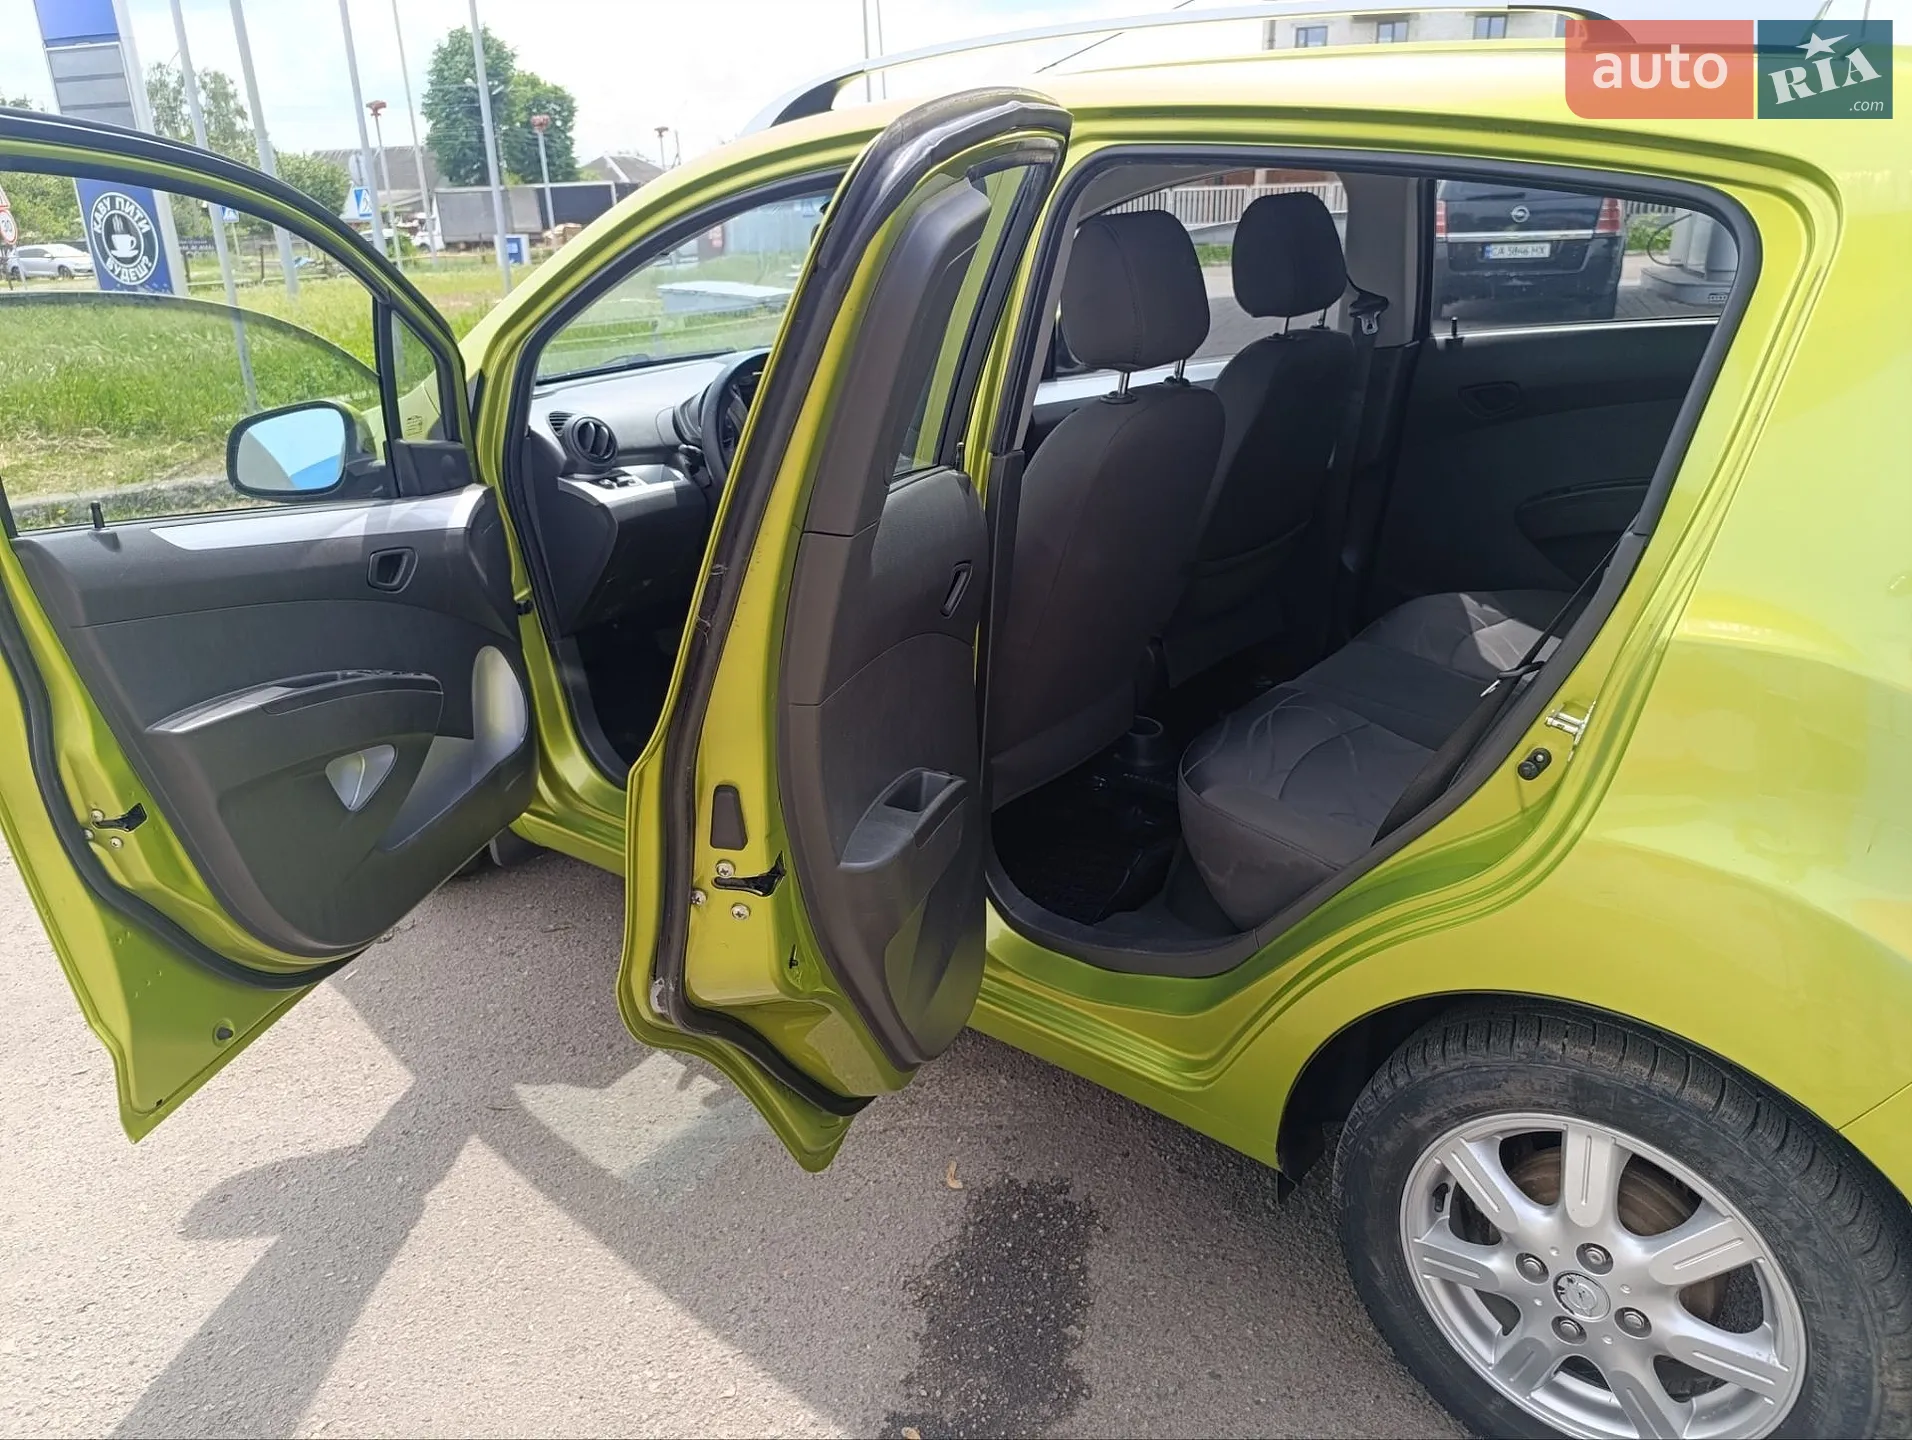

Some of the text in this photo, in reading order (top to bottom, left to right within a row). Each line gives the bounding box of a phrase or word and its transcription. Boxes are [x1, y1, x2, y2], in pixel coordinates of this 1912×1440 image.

[93, 196, 151, 234] КАВУ ПИТИ
[106, 255, 152, 283] БУДЕШ?
